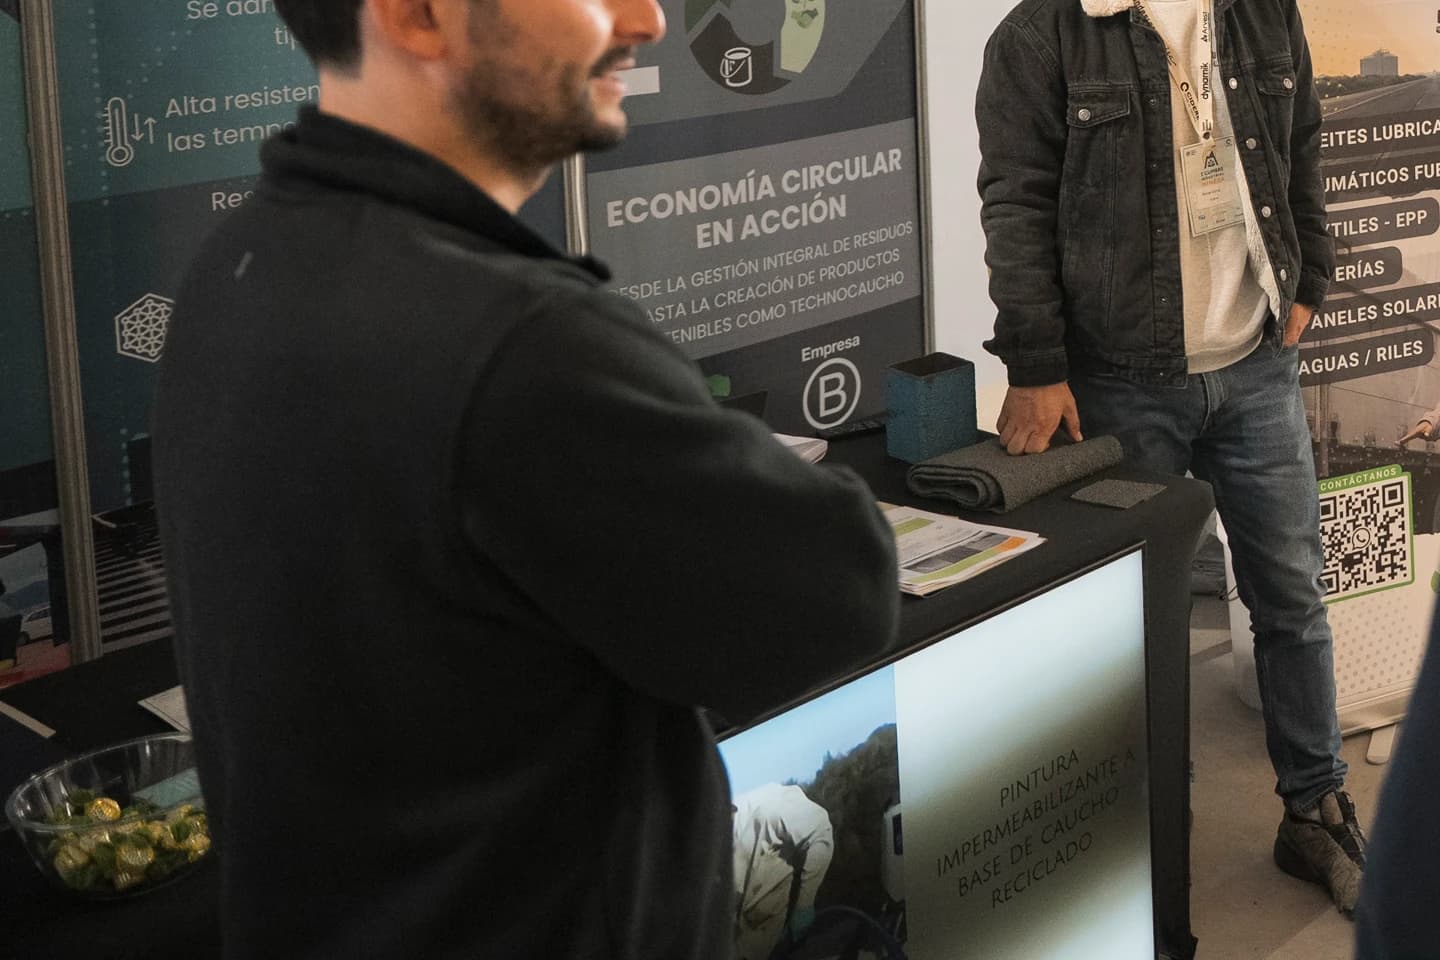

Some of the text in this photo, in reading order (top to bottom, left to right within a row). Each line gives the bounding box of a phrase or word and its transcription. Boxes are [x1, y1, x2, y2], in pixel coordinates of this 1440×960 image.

[186, 0, 219, 20] Se
[1200, 62, 1209, 100] dynamik
[165, 84, 321, 119] Alta resisten
[167, 132, 206, 153] las
[1320, 128, 1368, 148] EITES
[606, 148, 903, 228] ECONOMÍA CIRCULAR
[1324, 166, 1409, 192] UMÁTICOS
[696, 191, 847, 249] EN ACCIÓN
[1325, 216, 1379, 238] TILES
[1396, 209, 1428, 228] EPP
[667, 275, 687, 293] LA
[690, 258, 759, 287] GESTIÓN
[762, 243, 830, 272] INTEGRAL
[832, 237, 851, 254] DE
[853, 220, 913, 249] RESIDUOS
[1335, 259, 1385, 282] ERÍAS
[691, 297, 710, 314] LA
[714, 275, 794, 308] CREACIÓN
[797, 270, 816, 289] DE
[819, 247, 901, 282] PRODUCTOS
[664, 270, 905, 344] ENIBLES COMO TECHNOCAUCHO
[1310, 304, 1378, 330] ANELES
[801, 334, 861, 362] Empresa
[1298, 340, 1424, 376] AGUAS / RILES
[819, 372, 848, 418] B
[1319, 467, 1396, 492] CONTÁCTANOS
[1000, 748, 1080, 808] PINTURA
[936, 747, 1136, 877] IMPERMEABILIZANTE A
[958, 785, 1120, 897] BASE DE CAUCHO
[991, 831, 1093, 909] RECICLADO
